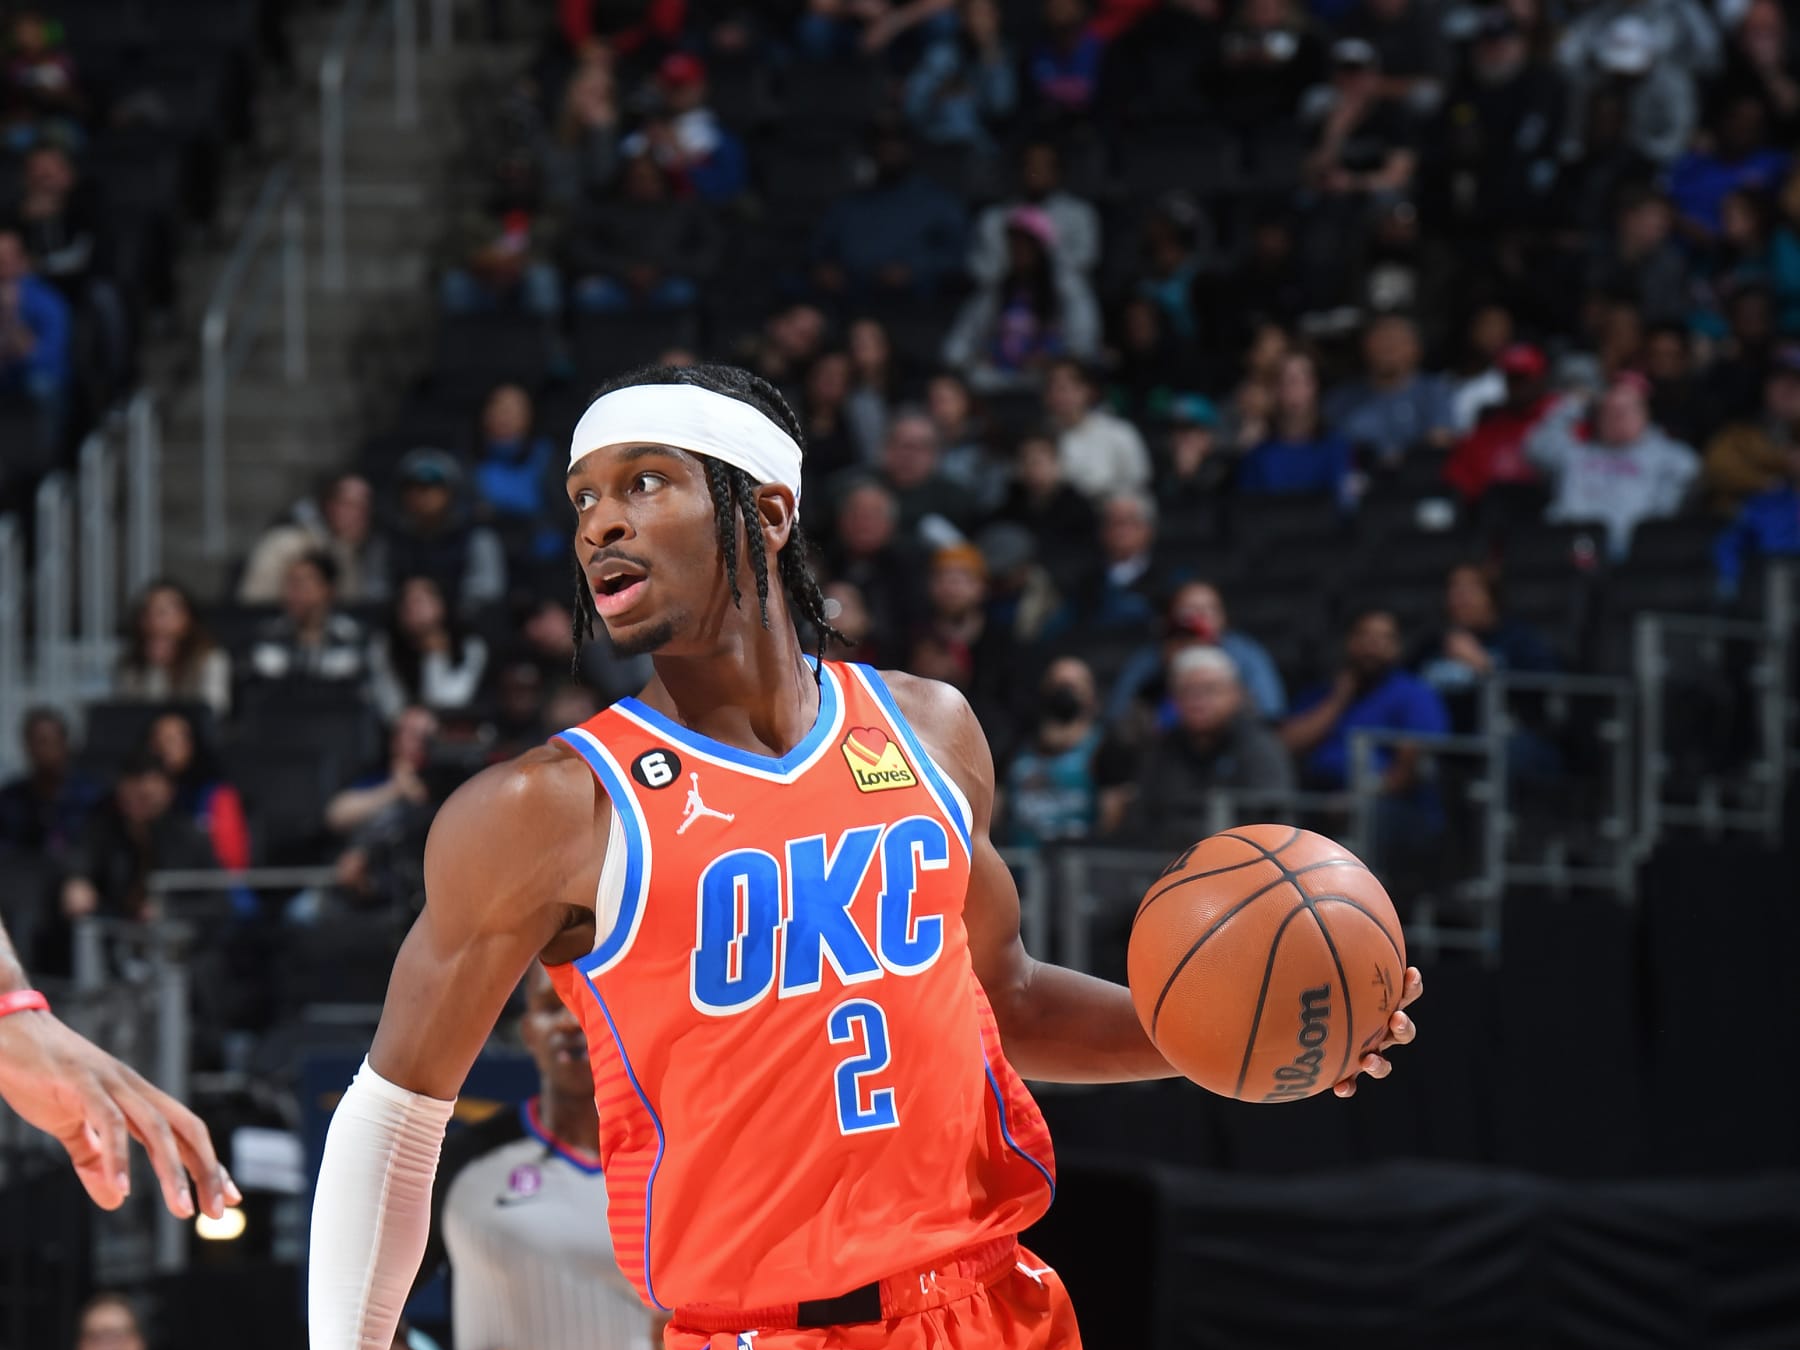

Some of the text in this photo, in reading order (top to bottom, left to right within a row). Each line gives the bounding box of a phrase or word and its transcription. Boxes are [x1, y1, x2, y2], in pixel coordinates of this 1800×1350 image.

[640, 752, 674, 787] 6
[690, 814, 950, 1017] OKC
[826, 998, 900, 1136] 2
